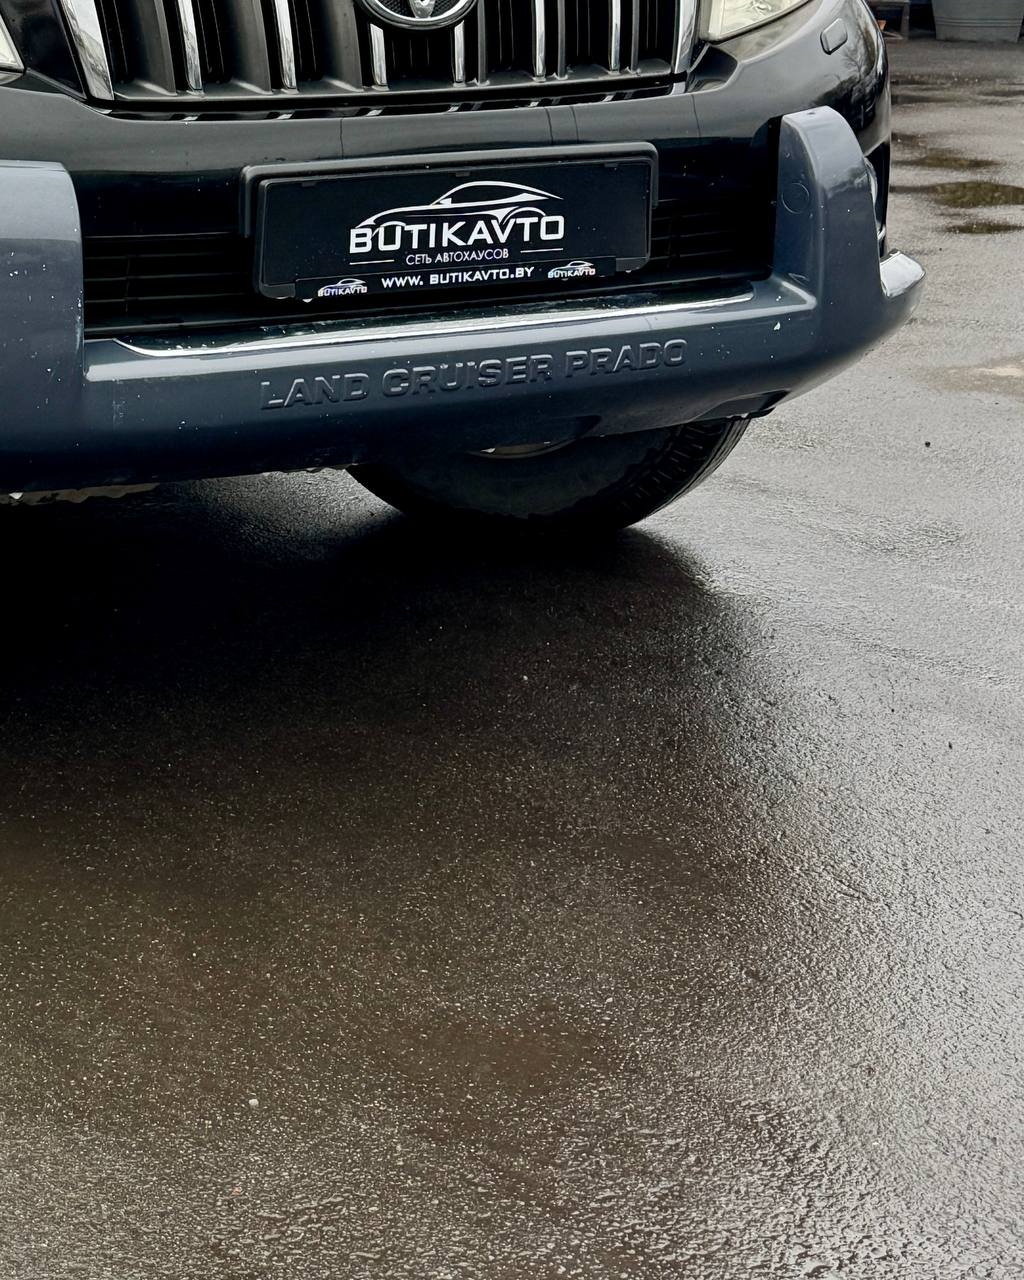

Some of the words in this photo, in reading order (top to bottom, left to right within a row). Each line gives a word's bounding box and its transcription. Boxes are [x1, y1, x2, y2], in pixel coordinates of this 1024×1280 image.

[349, 215, 565, 254] BUTIKAVTO
[405, 253, 433, 266] СЕТЬ
[434, 248, 510, 264] АВТОХАУСОВ
[429, 266, 535, 285] BUTIKAVTO.BY
[547, 268, 596, 279] BUTIKAVTO
[317, 286, 368, 297] BUTIKAVTO
[259, 372, 370, 410] LAND
[382, 354, 554, 398] CRUISER
[565, 338, 688, 378] PRADO
